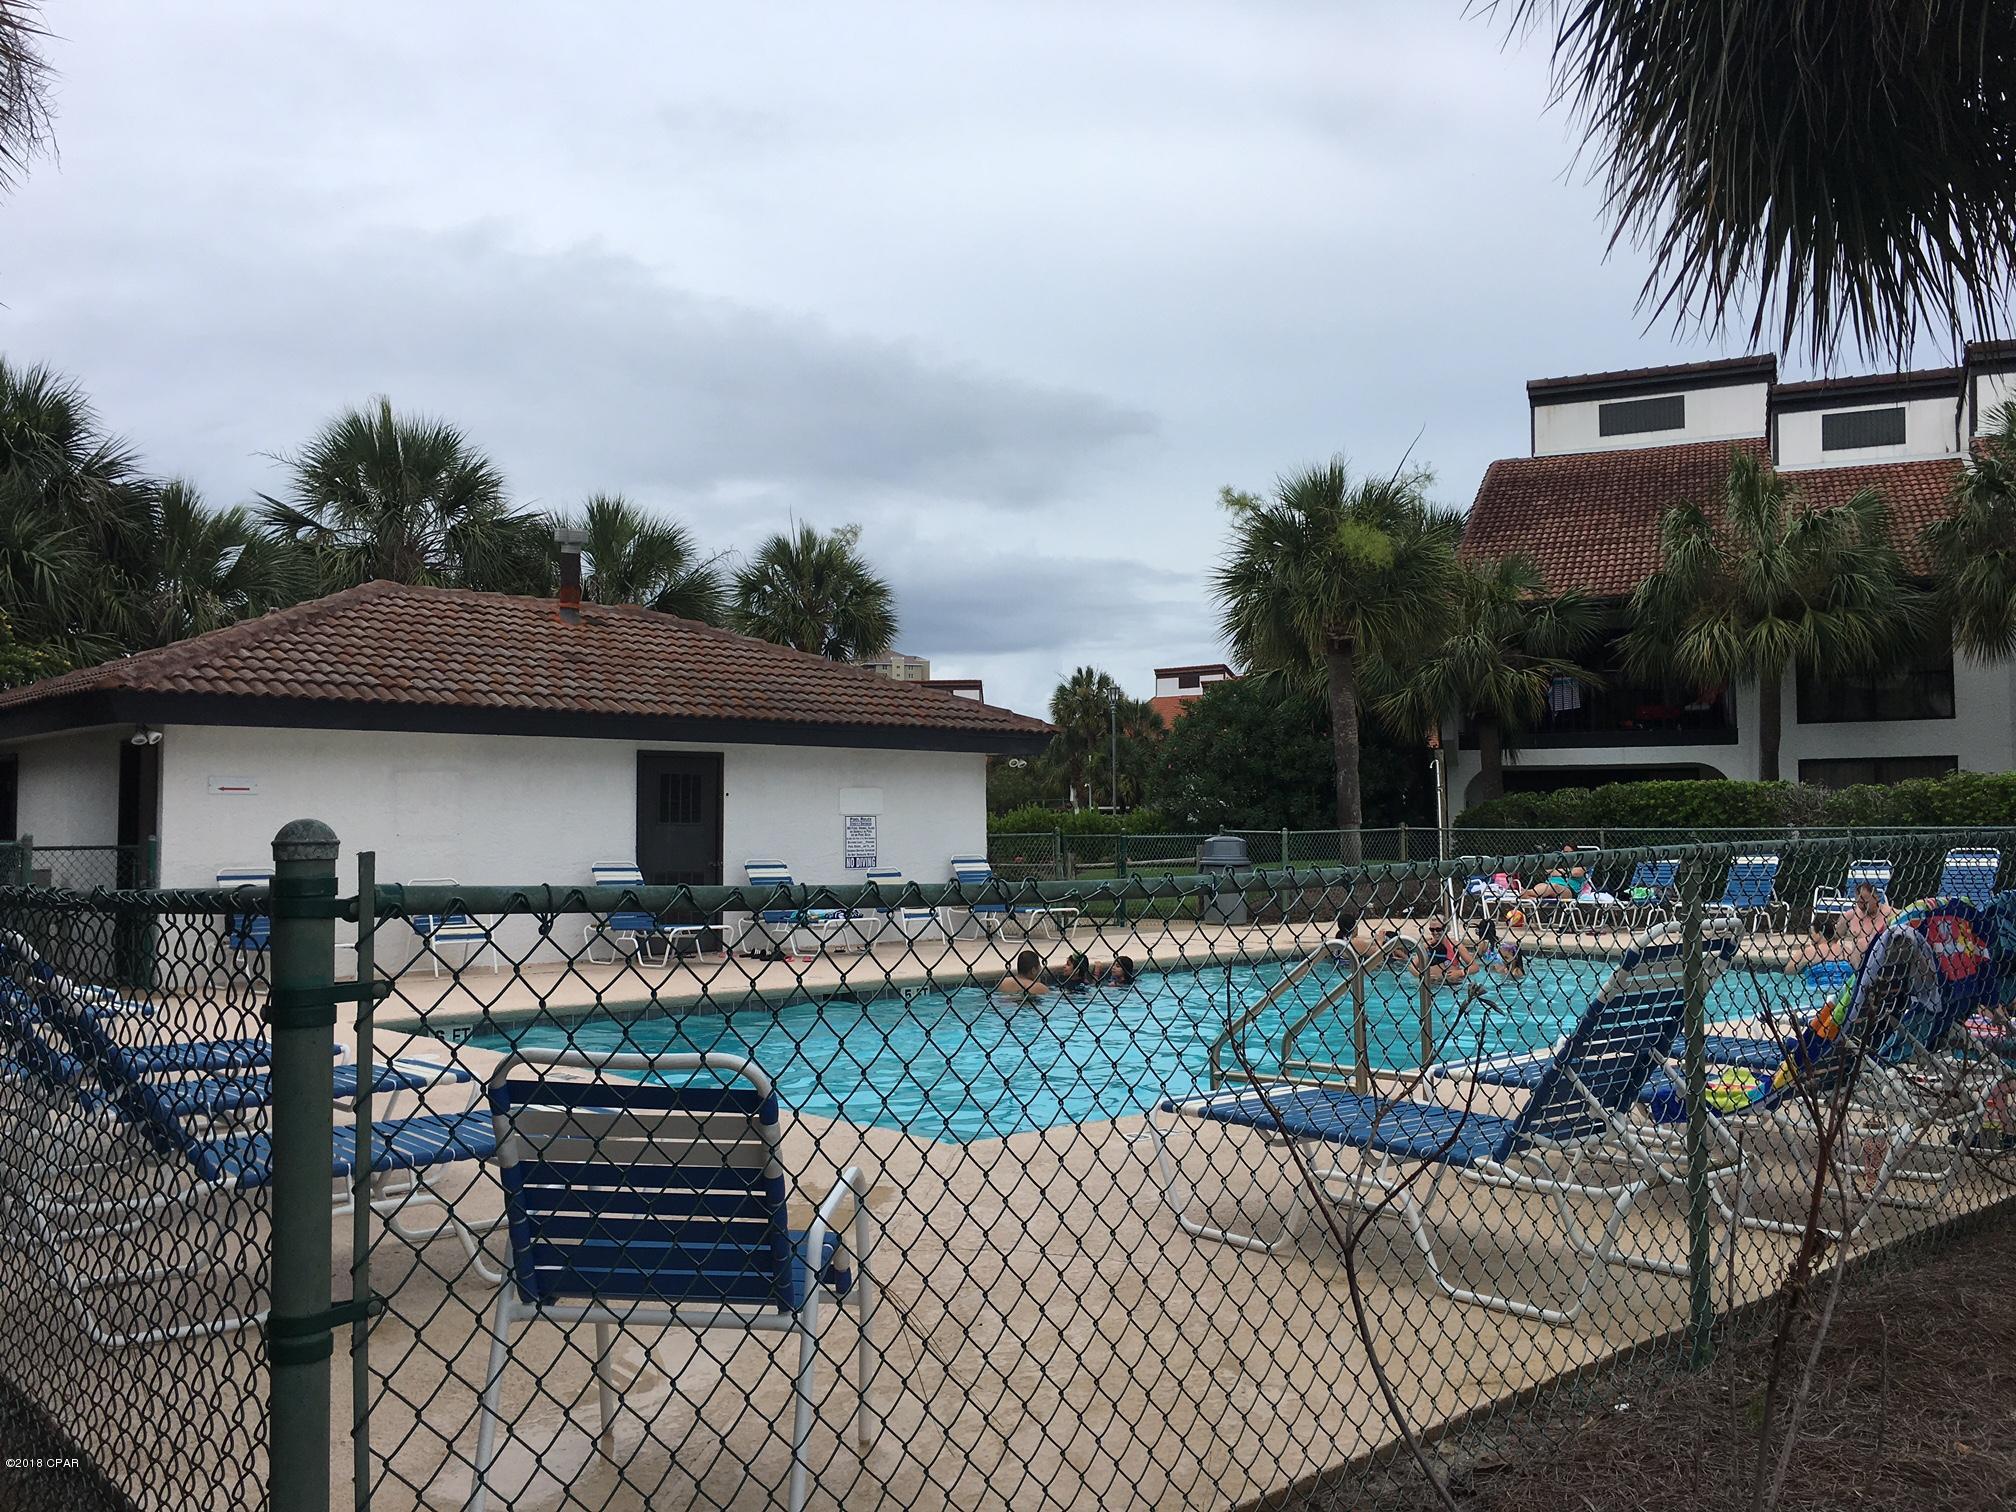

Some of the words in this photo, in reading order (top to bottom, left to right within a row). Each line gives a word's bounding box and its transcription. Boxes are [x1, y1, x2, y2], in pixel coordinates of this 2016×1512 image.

[847, 858, 855, 867] NO
[856, 857, 875, 867] DIVING
[905, 989, 912, 998] 5
[453, 1028, 471, 1041] FT
